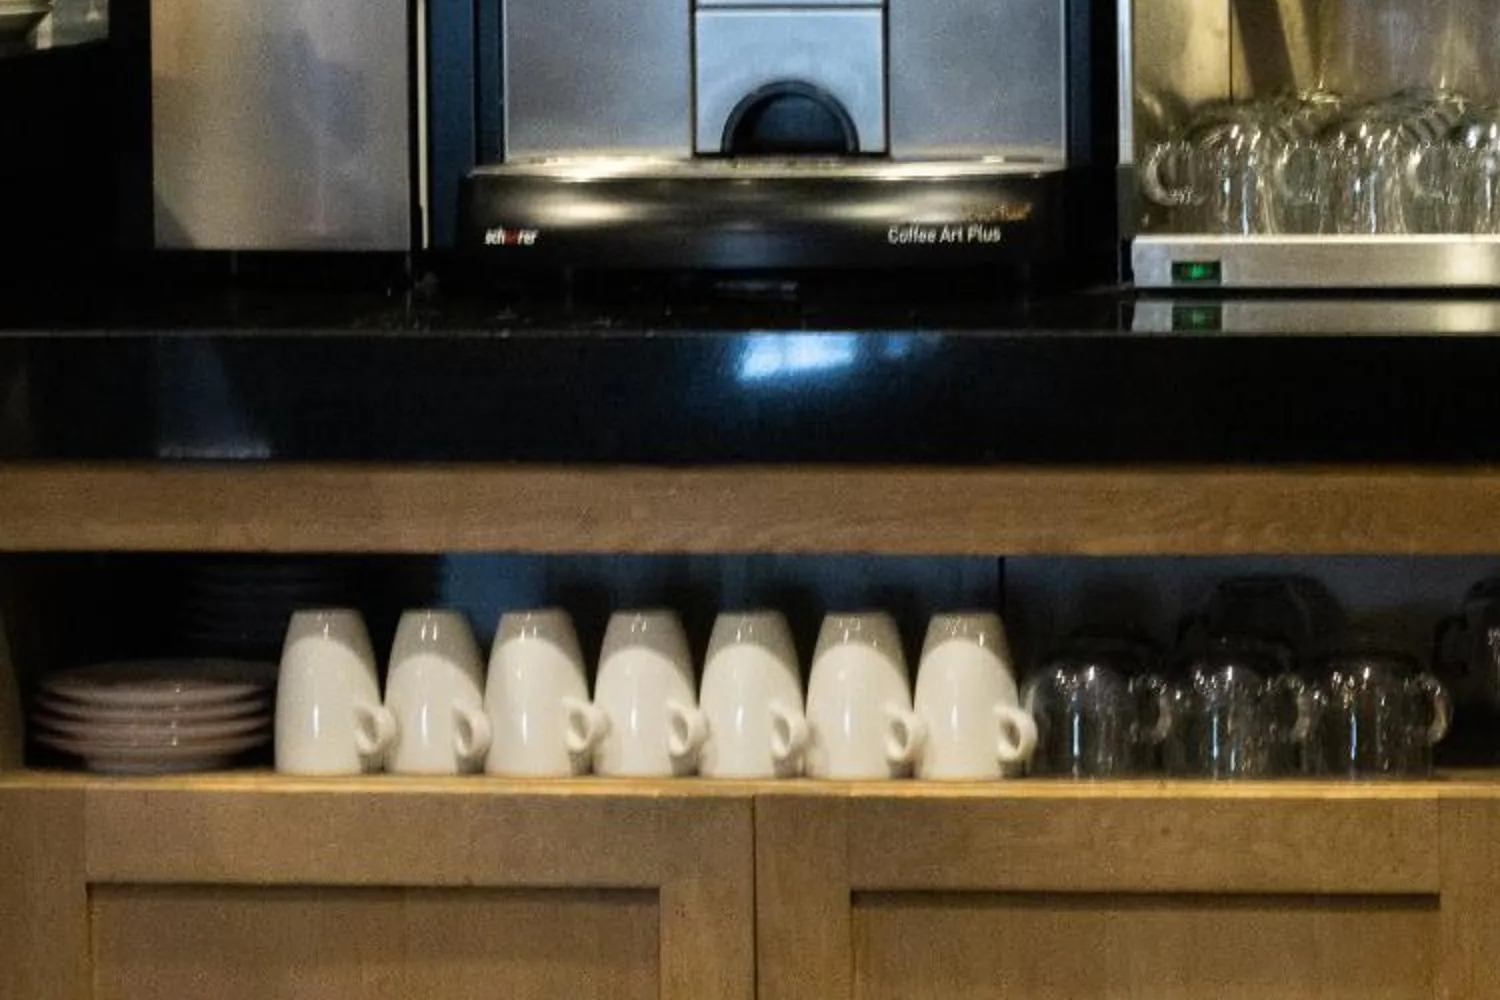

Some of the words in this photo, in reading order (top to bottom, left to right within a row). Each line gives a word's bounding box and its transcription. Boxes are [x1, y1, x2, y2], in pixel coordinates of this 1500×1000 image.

[485, 228, 538, 245] schrer
[888, 224, 936, 244] Coffee
[939, 223, 963, 243] Art
[967, 223, 1001, 243] Plus
